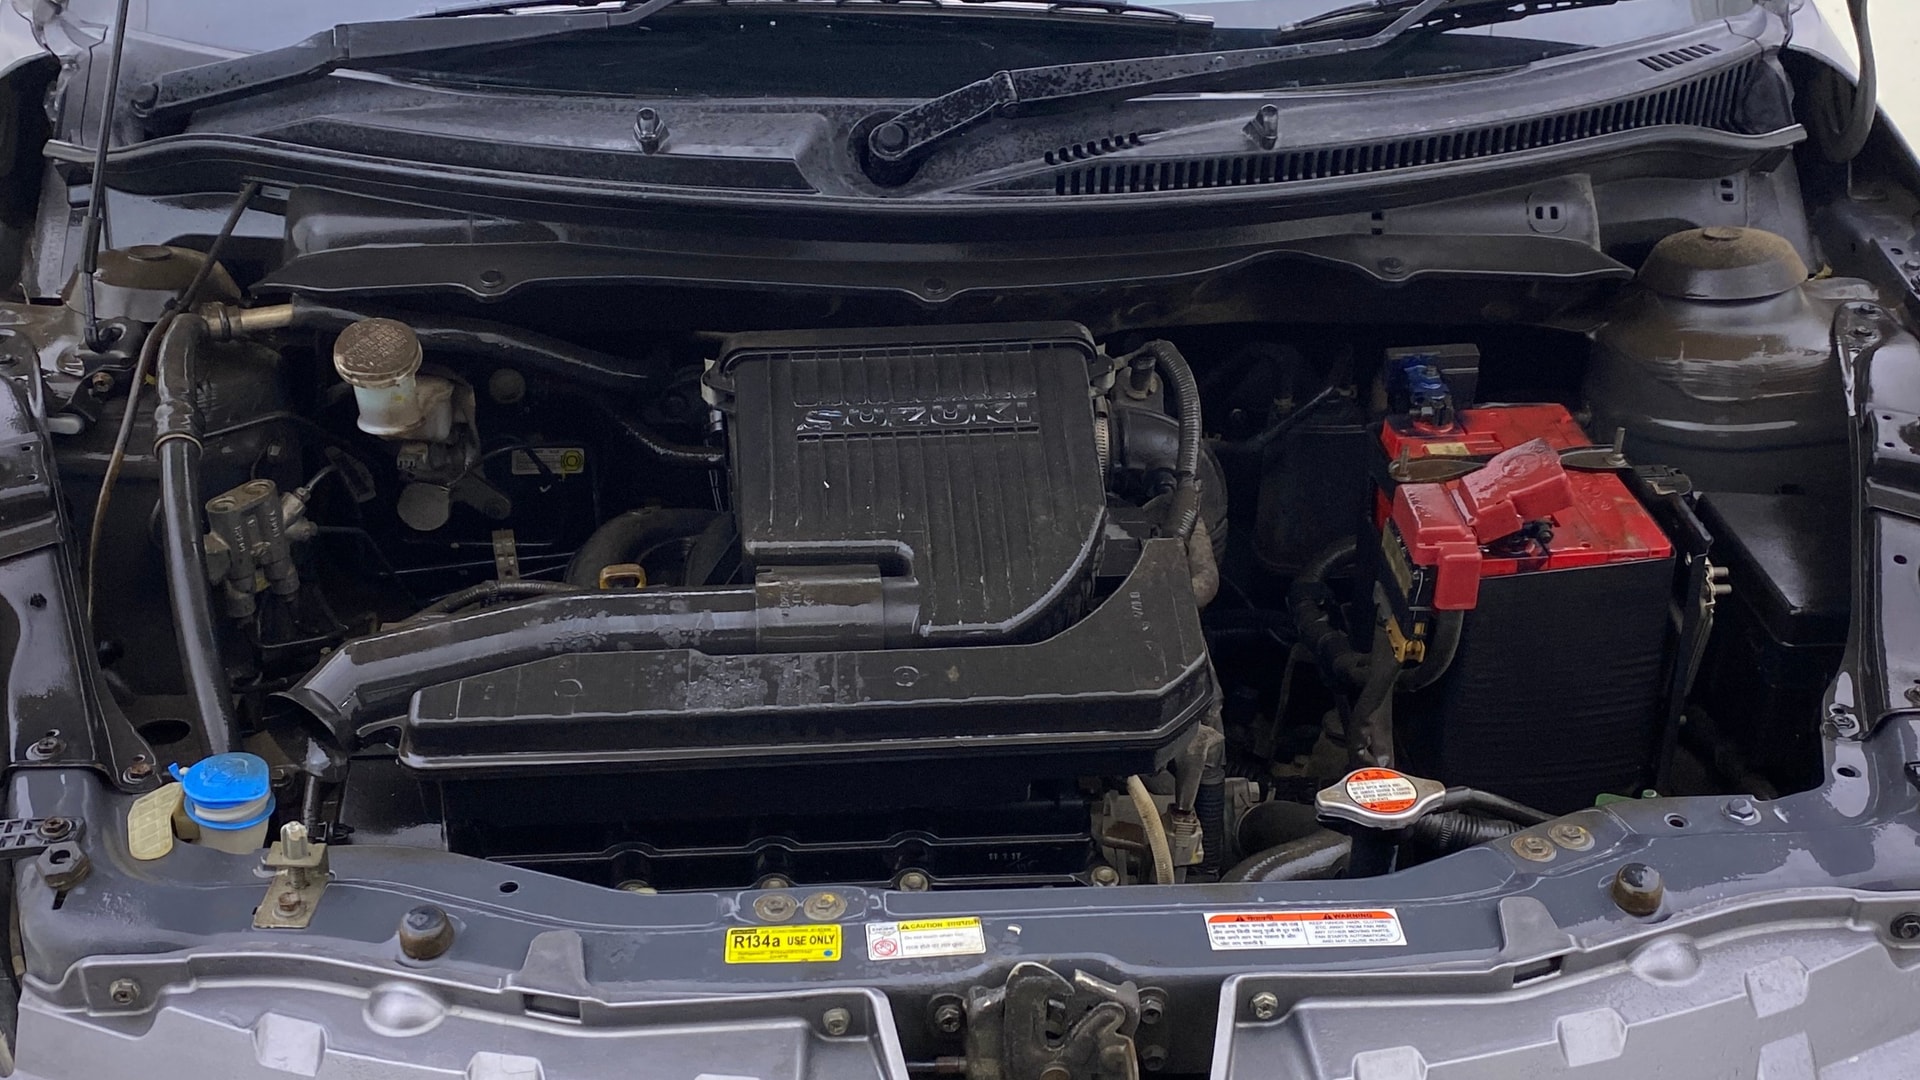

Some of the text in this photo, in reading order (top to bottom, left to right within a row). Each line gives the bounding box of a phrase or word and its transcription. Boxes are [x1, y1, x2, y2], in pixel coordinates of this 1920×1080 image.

[796, 401, 1033, 431] SUZUKI
[734, 935, 835, 948] R134a USE ONLY
